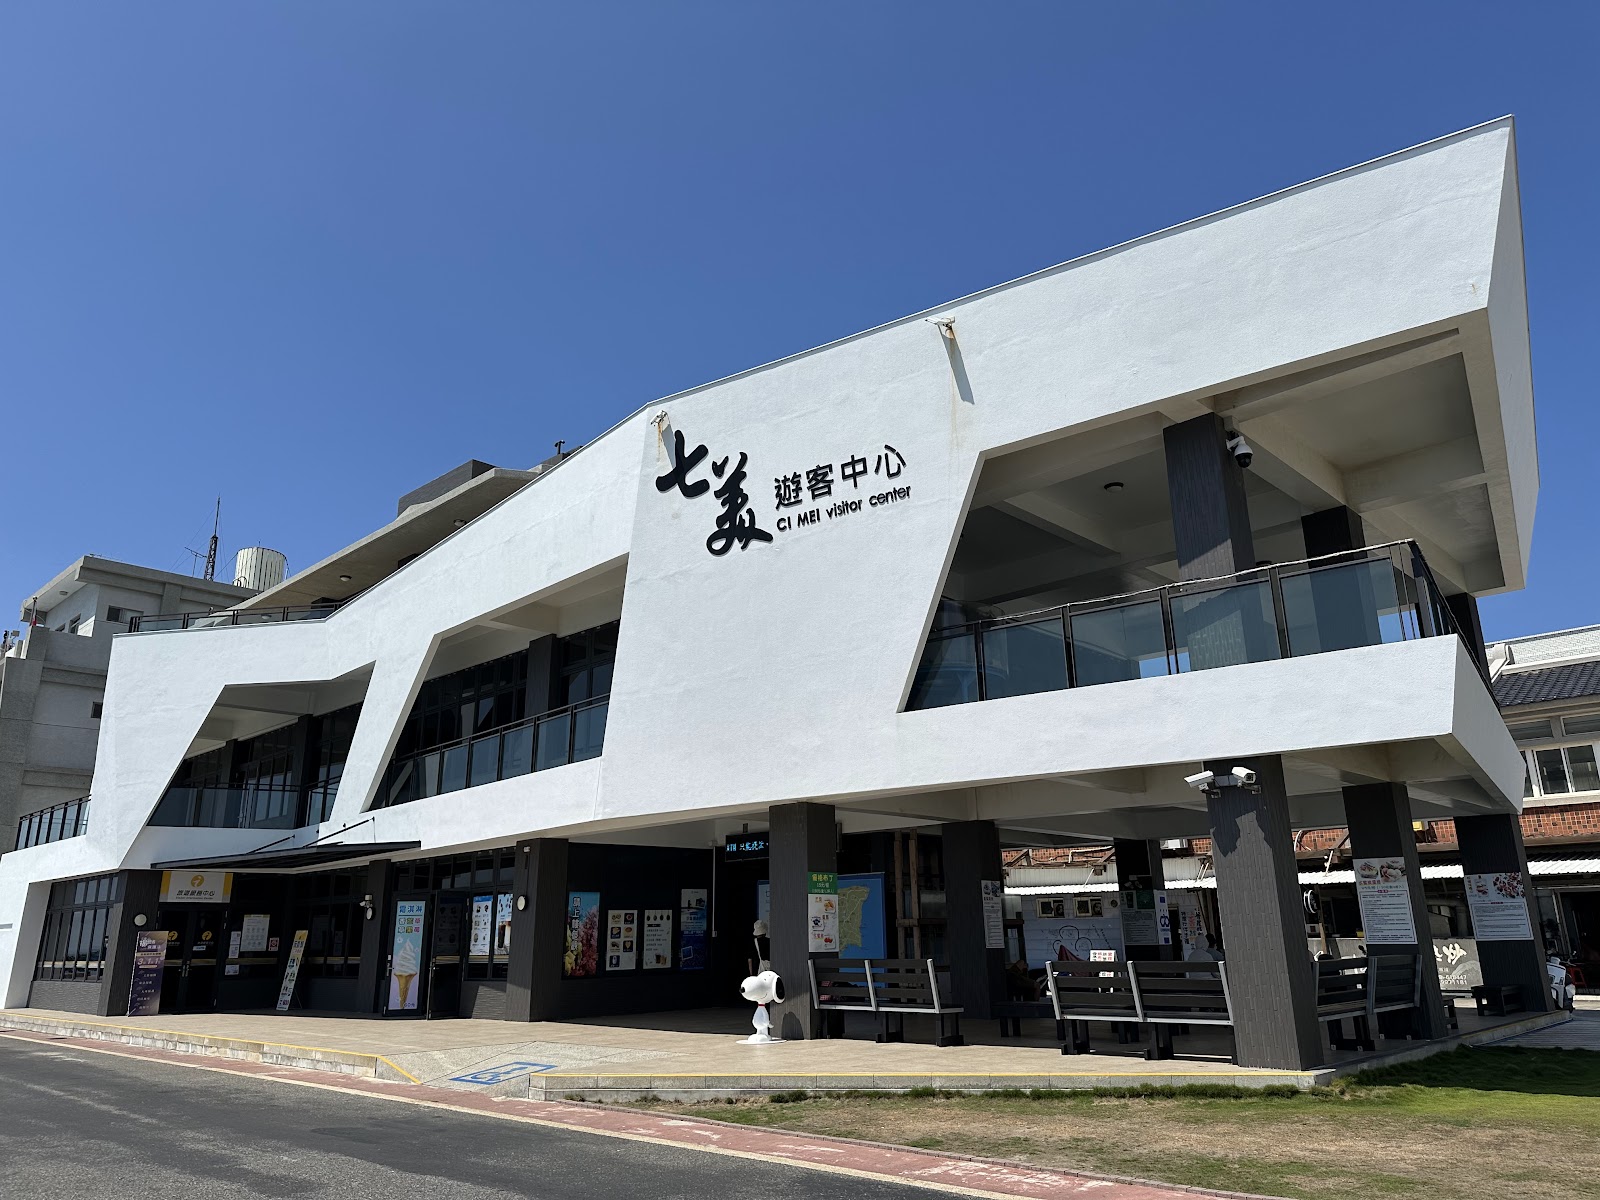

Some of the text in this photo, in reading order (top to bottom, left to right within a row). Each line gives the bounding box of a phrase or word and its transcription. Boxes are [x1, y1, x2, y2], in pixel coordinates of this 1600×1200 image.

[655, 430, 774, 556] 七美
[774, 444, 907, 510] 遊客中心
[776, 485, 912, 532] CI MEI visitor center
